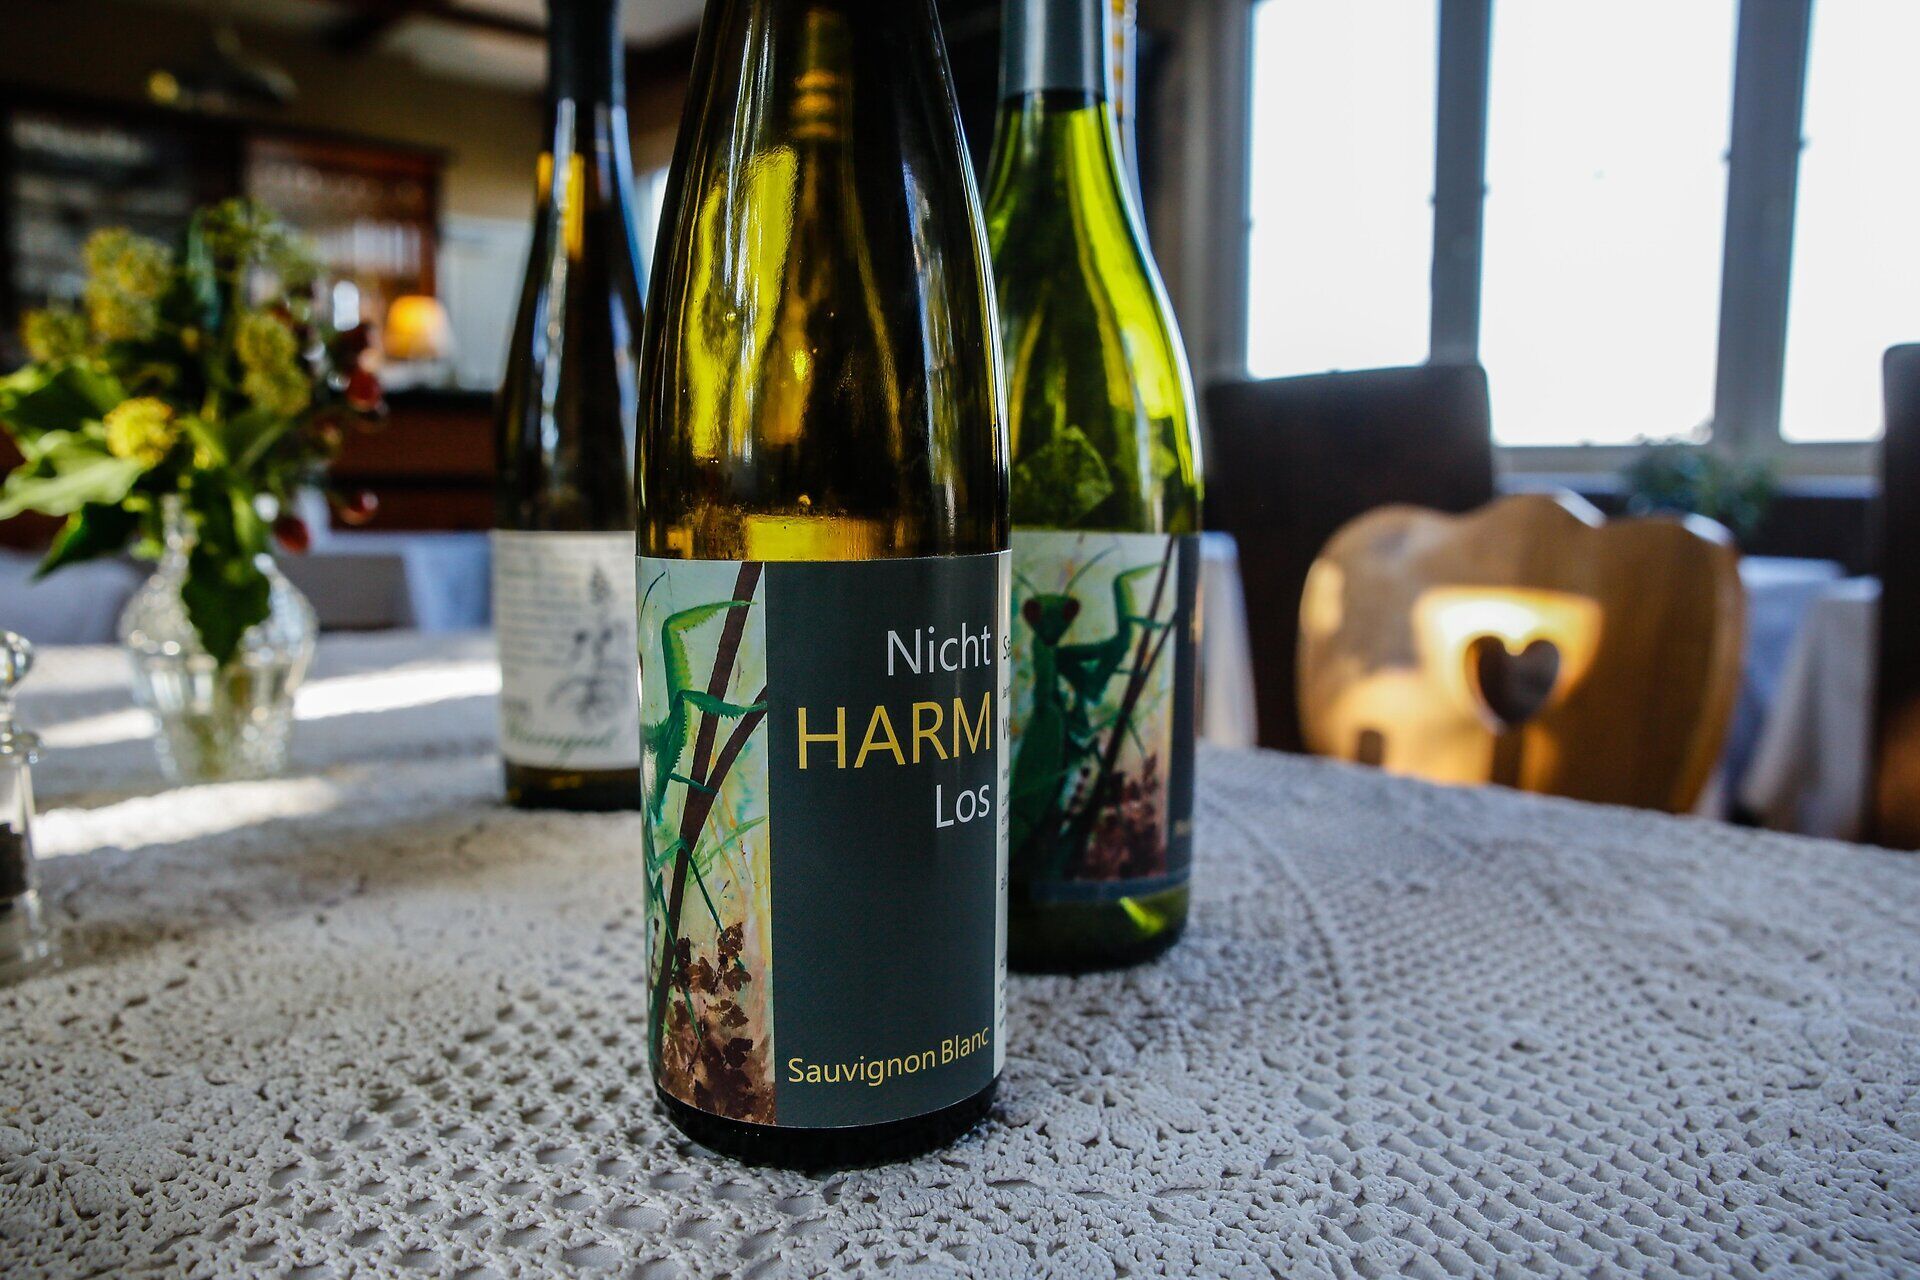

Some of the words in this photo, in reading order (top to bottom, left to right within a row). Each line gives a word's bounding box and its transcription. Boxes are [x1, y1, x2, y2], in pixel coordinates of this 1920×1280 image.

[887, 622, 991, 676] Nicht
[798, 691, 991, 770] HARM
[936, 784, 990, 829] Los
[788, 1050, 936, 1087] Sauvignon
[941, 1027, 989, 1065] Blanc
